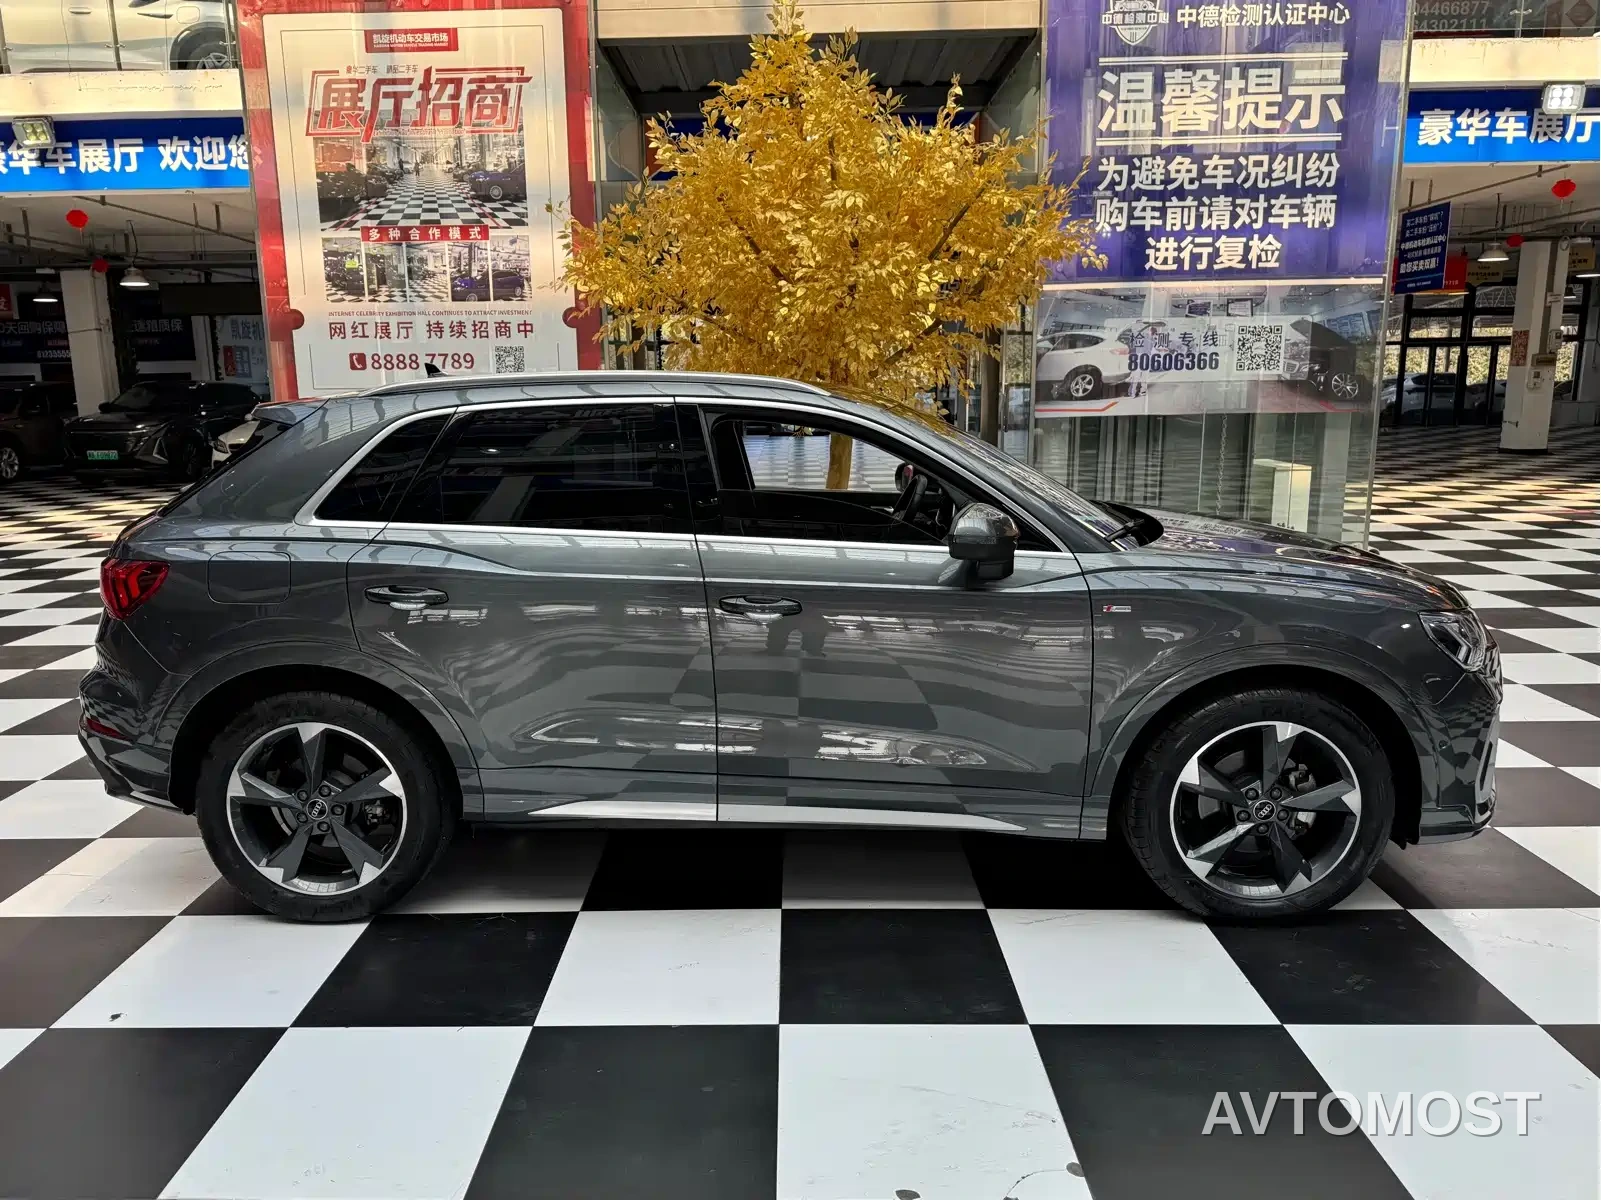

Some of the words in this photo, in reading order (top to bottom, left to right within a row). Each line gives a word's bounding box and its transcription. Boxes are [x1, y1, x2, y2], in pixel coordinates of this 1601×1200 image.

[1177, 2, 1350, 28] 中德检测认证中心
[373, 32, 448, 44] 凯旋机动车交易市场
[317, 65, 533, 144] 展厅招商
[1098, 67, 1345, 132] 温馨提示
[1417, 107, 1601, 146] 豪华车展厅
[157, 134, 261, 173] 欢迎您
[1097, 152, 1340, 192] 为避免车况纠纷
[1095, 193, 1337, 232] 购车前请对车辆
[369, 226, 482, 241] 多种合作模式
[1144, 234, 1282, 271] 进行复检
[329, 320, 413, 340] 网红展厅
[427, 319, 534, 339] 持续招商中
[1129, 331, 1218, 348] 检测专线
[371, 353, 420, 370] 8888
[424, 352, 475, 370] 7789
[1127, 351, 1219, 371] 80606366
